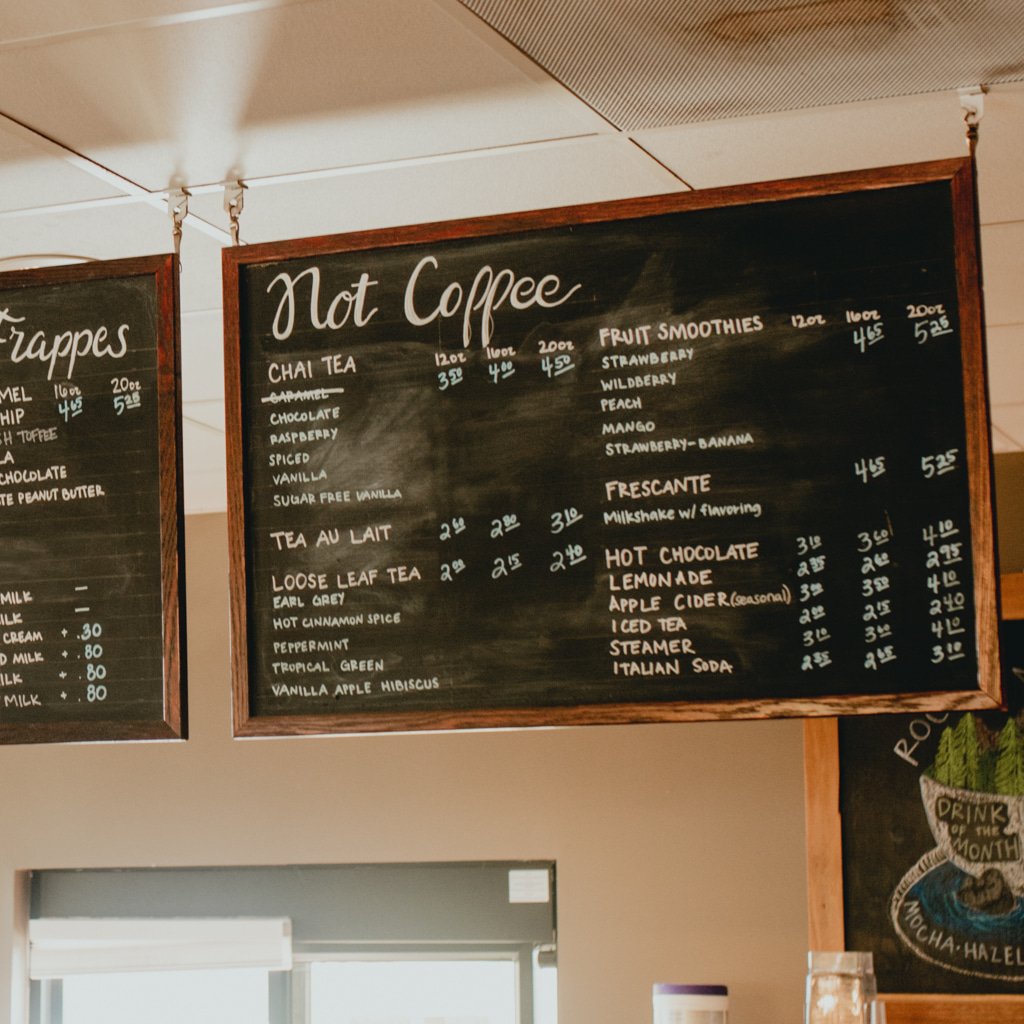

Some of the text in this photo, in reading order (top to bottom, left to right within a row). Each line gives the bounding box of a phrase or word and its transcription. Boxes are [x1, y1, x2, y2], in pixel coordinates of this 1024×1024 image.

[267, 256, 581, 348] Not Coffee
[599, 326, 652, 347] FRUIT
[657, 315, 763, 341] SMOOTHIES
[601, 347, 694, 370] STRAWBERRY
[268, 359, 313, 383] CHAI
[321, 355, 357, 376] TEA
[600, 372, 677, 391] WILDBERRY
[601, 397, 642, 412] PEACH
[270, 408, 340, 424] CHOCOLATE
[17, 427, 58, 444] TOFFEE
[270, 428, 338, 445] RASPBERRY
[602, 421, 655, 435] MANGO
[269, 454, 310, 467] SPICED
[272, 470, 327, 486] VANILLA
[18, 488, 59, 504] PEANUT
[62, 484, 105, 501] BUTTER
[605, 474, 711, 501] FRESCANTE
[273, 488, 402, 507] SUGAR FREE VANILLA
[603, 507, 676, 525] Milkshake
[700, 502, 762, 519] flavoring
[270, 525, 392, 550] TEA AU LAIT
[605, 542, 760, 568] HOT CHOCOLATE
[272, 566, 422, 592] LOOSE LEAF TEA
[609, 570, 713, 591] LEMONADE
[0, 591, 33, 604] MILK
[272, 592, 345, 609] EARL GREY
[273, 612, 401, 630] HOT CINNAMON SPICE
[612, 616, 687, 634] ICED TEA
[2, 630, 43, 644] CREAM
[273, 638, 349, 654] PEPPERMINT
[609, 638, 696, 655] STEAMER
[12, 650, 44, 664] MILK
[272, 659, 384, 675] TROPICAL GREEN
[614, 658, 733, 676] ITALIAN SODA
[272, 678, 440, 697] VANILLA APPLE HIBISCUS
[4, 693, 41, 707] MILK
[937, 797, 1005, 823] DRINK
[951, 825, 999, 837] OF THE
[953, 837, 1019, 861] MONTH
